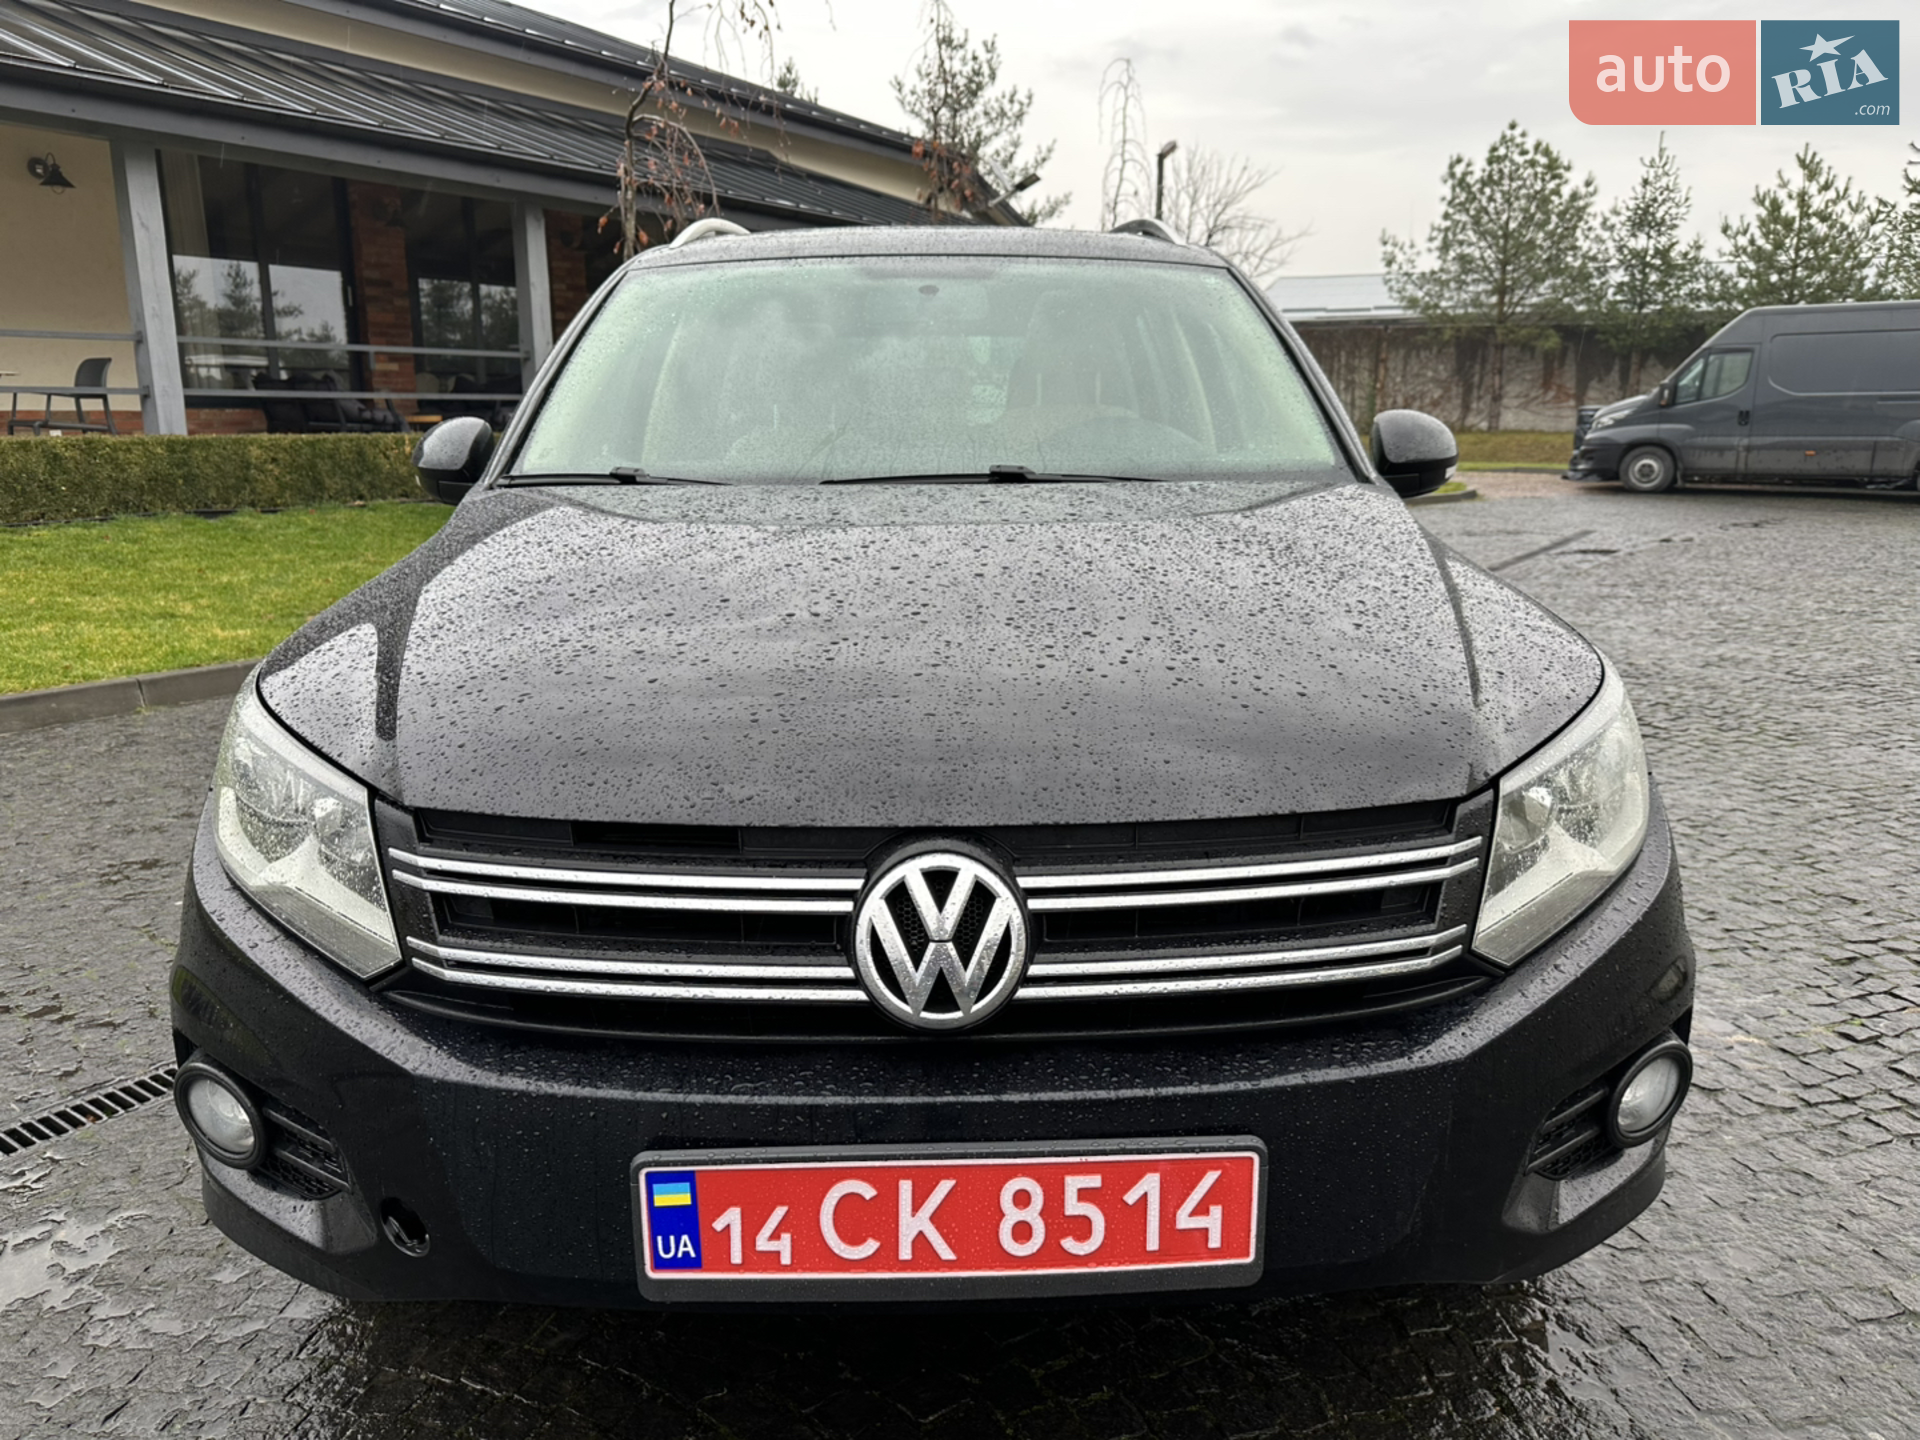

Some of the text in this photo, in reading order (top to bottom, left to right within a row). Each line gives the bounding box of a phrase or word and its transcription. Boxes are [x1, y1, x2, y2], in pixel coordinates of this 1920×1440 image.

[656, 1235, 697, 1260] UA
[711, 1169, 1224, 1266] 14 CK 8514
